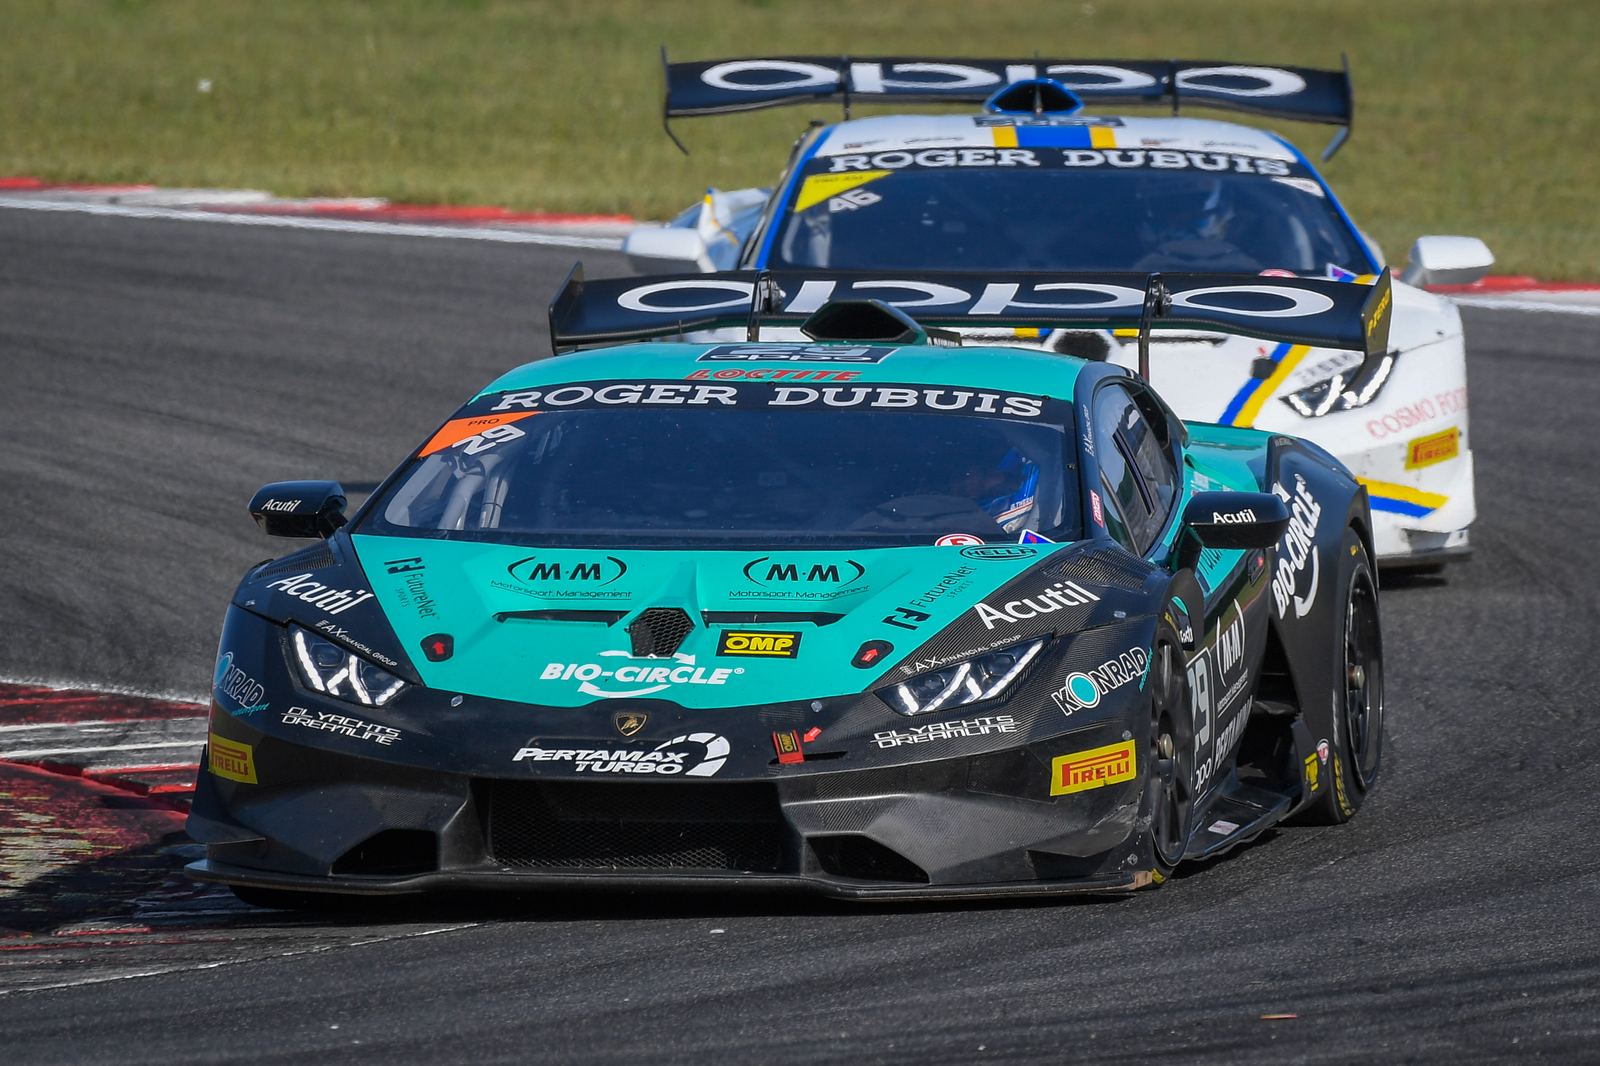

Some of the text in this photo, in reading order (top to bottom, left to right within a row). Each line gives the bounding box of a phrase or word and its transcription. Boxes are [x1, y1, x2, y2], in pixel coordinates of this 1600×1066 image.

[829, 148, 1291, 176] ROGER DUBUIS
[829, 188, 882, 213] 46
[684, 368, 863, 381] LOCTITE
[491, 384, 1043, 417] ROGER DUBUIS
[468, 418, 500, 426] PRO
[1367, 399, 1436, 438] COSMO
[452, 424, 526, 456] 29
[261, 499, 302, 513] Acutil
[1213, 509, 1257, 524] Acutil
[968, 548, 1037, 558] HELLA
[266, 572, 375, 616] Acutil
[404, 573, 437, 619] FutureNet
[556, 590, 633, 598] Management
[795, 585, 871, 599] Management
[910, 564, 977, 608] FutureNet
[974, 581, 1101, 630] Acutil
[724, 636, 794, 652] OMP
[940, 646, 990, 664] FINANCIAL
[990, 634, 1022, 648] GROUP
[372, 652, 398, 667] GROUP
[1051, 646, 1148, 717] KONRAD
[281, 714, 396, 746] DREAMLINE
[317, 712, 402, 738] YACHTS
[877, 722, 1018, 749] DREAMLINE
[909, 715, 1014, 734] YACHTS
[512, 747, 690, 763] PERTAMAX
[574, 760, 687, 775] TURBO
[1061, 749, 1131, 788] PIRELLI
